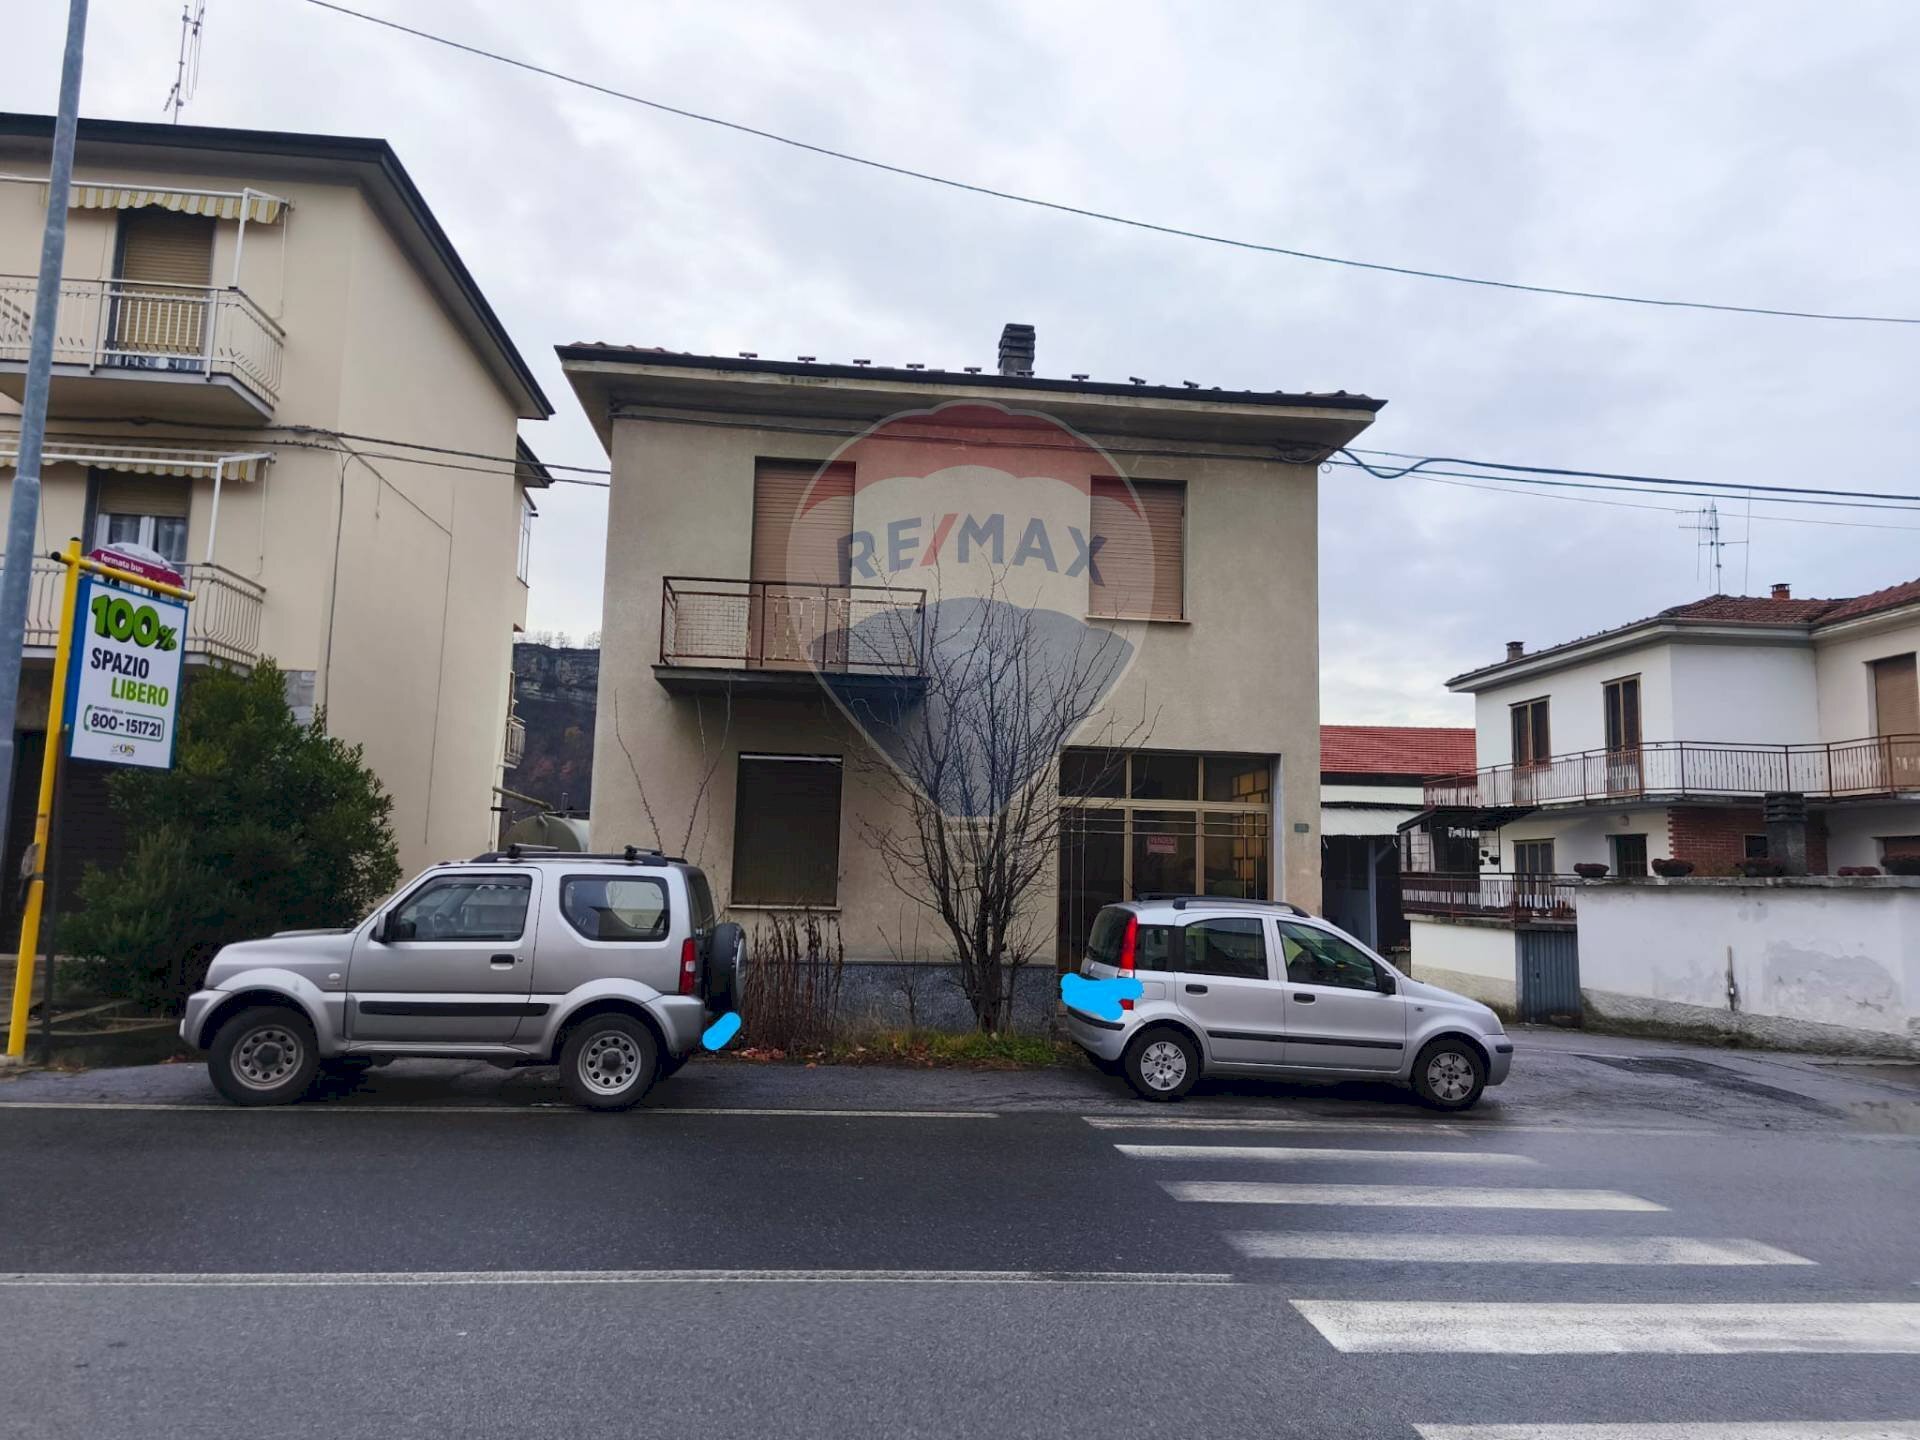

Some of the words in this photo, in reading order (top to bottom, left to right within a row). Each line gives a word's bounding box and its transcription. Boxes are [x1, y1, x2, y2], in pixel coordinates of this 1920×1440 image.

[101, 553, 130, 569] fermata
[130, 563, 144, 573] bus
[91, 595, 177, 651] 100%
[91, 647, 149, 678] SPAZIO
[111, 677, 168, 707] LIBERO
